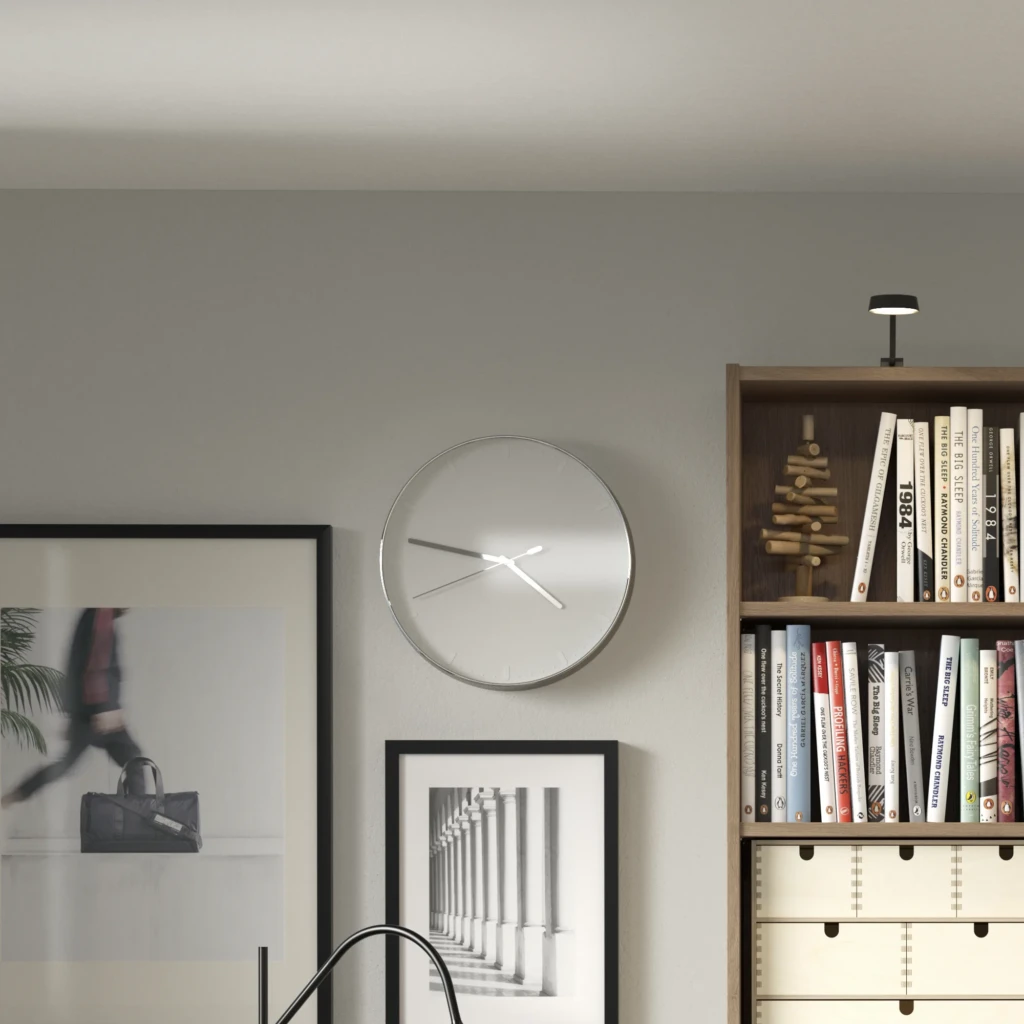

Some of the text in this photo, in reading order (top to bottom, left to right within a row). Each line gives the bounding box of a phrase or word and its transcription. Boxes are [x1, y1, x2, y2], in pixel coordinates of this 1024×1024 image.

[878, 469, 885, 480] OF
[880, 448, 888, 466] EPIC
[955, 431, 963, 503] THE BIG SLEEP
[972, 446, 980, 481] Hundred
[868, 483, 883, 531] GILGAMESH
[899, 481, 913, 529] 1984
[972, 507, 980, 517] of
[906, 532, 912, 540] by
[972, 520, 980, 551] Solitude
[904, 666, 915, 715] Carrie's War
[942, 686, 950, 707] SLEEP
[834, 706, 848, 795] PROFILING HACKERS
[965, 705, 976, 781] Grimm's Fairy Tales
[931, 735, 944, 808] RAYMOND CHANDLER
